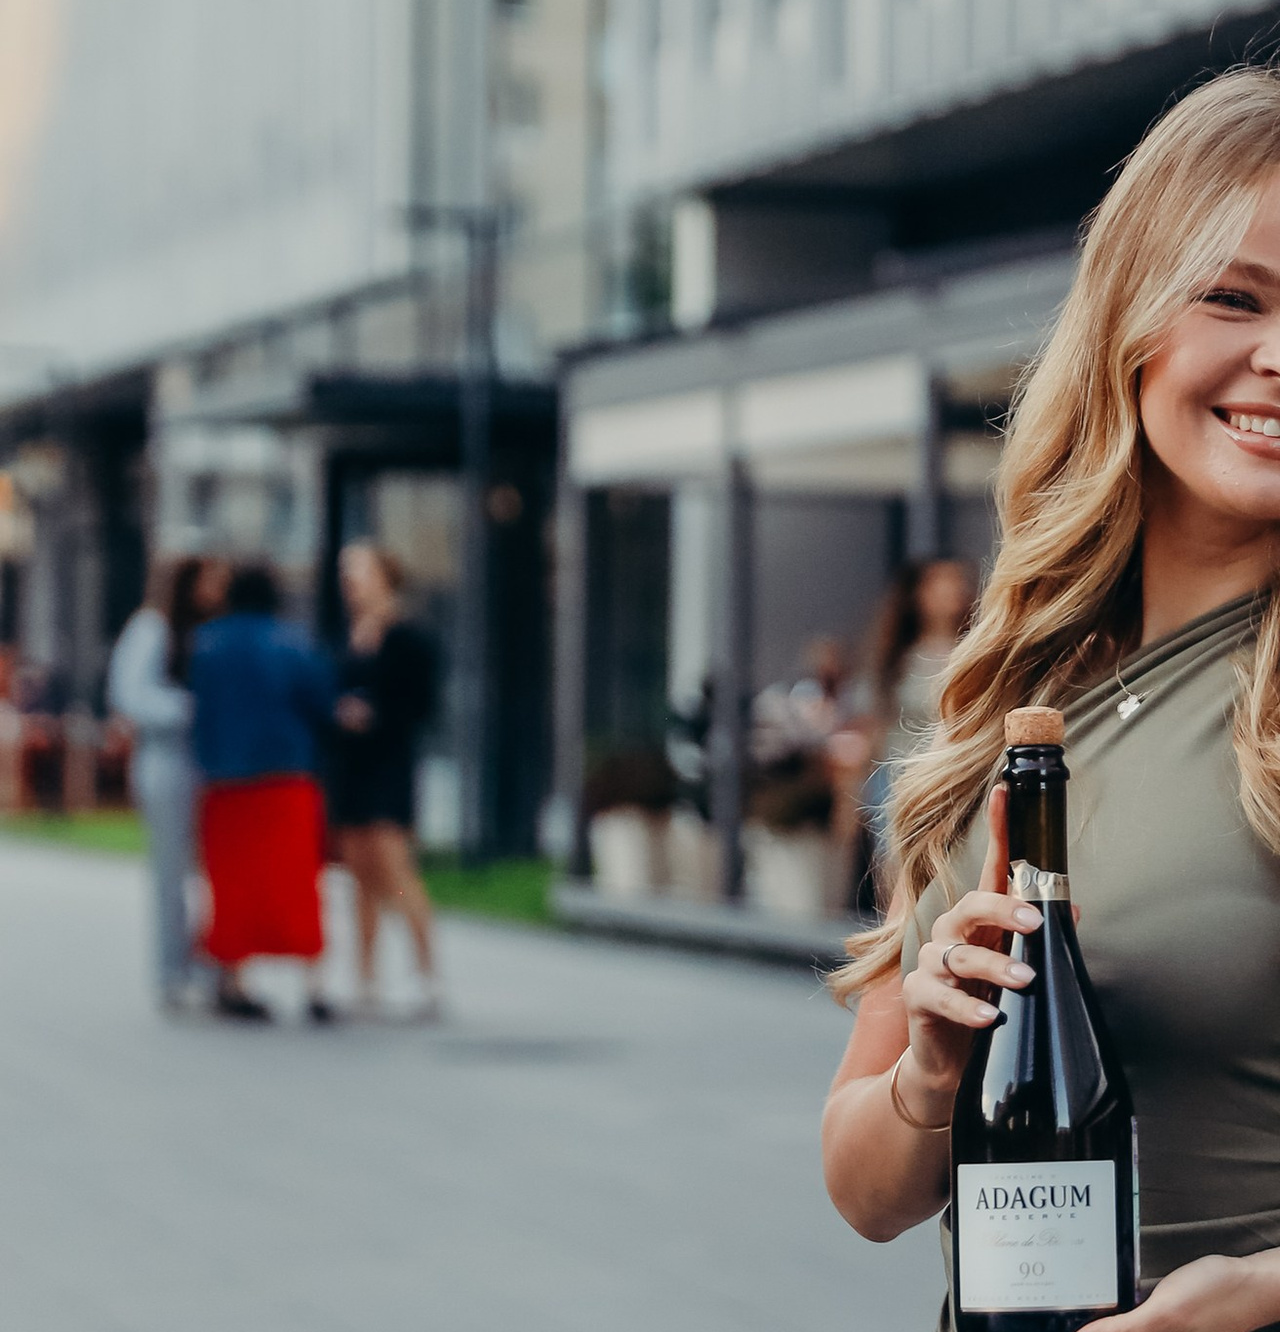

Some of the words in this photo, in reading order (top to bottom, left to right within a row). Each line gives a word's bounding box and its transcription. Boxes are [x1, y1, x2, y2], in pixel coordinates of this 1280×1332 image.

[975, 1184, 1092, 1210] ADAGUM
[989, 1212, 1077, 1221] RESERVE
[1018, 1261, 1046, 1280] 90
